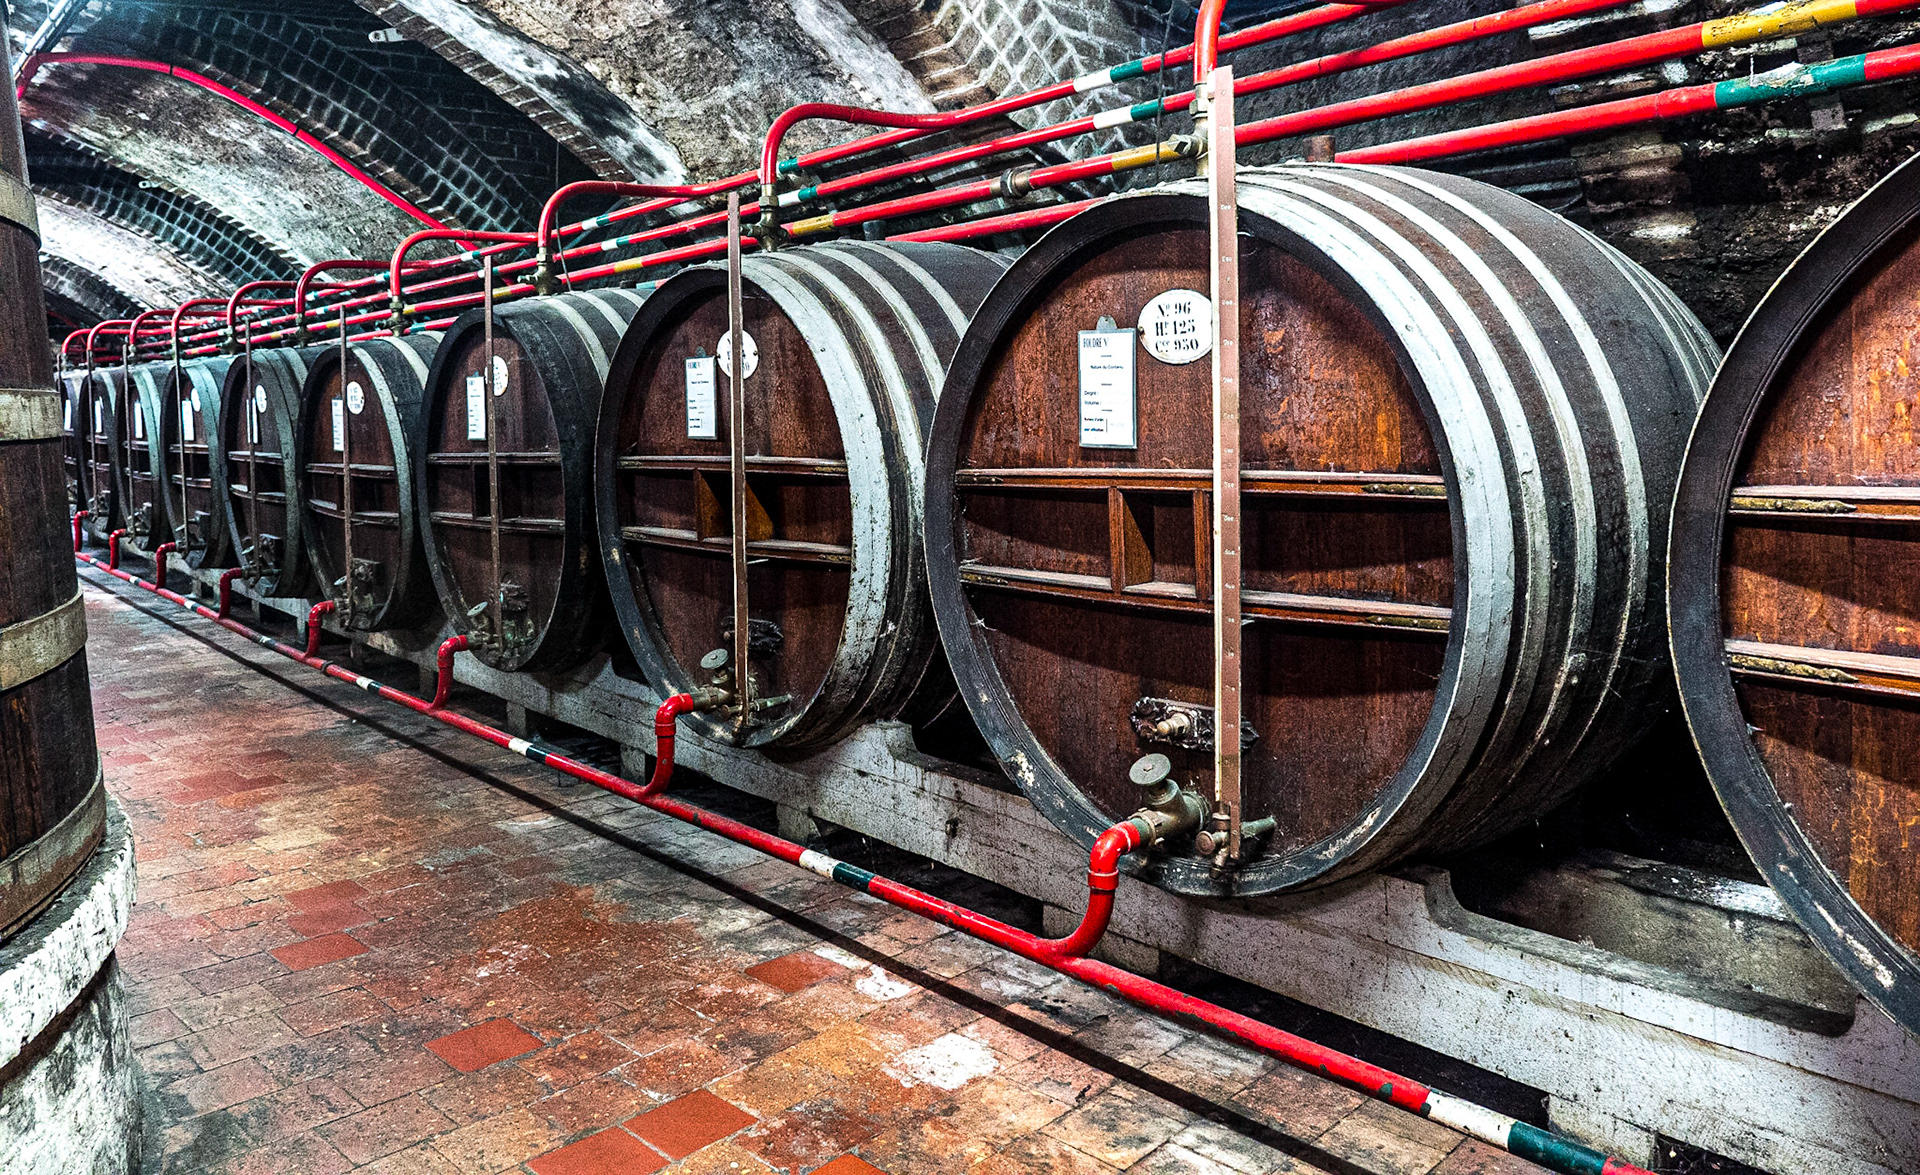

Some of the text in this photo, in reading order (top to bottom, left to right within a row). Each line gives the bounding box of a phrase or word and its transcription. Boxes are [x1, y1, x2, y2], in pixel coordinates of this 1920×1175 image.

[1174, 301, 1191, 314] 96
[1173, 319, 1196, 335] 125
[1174, 338, 1199, 351] 950
